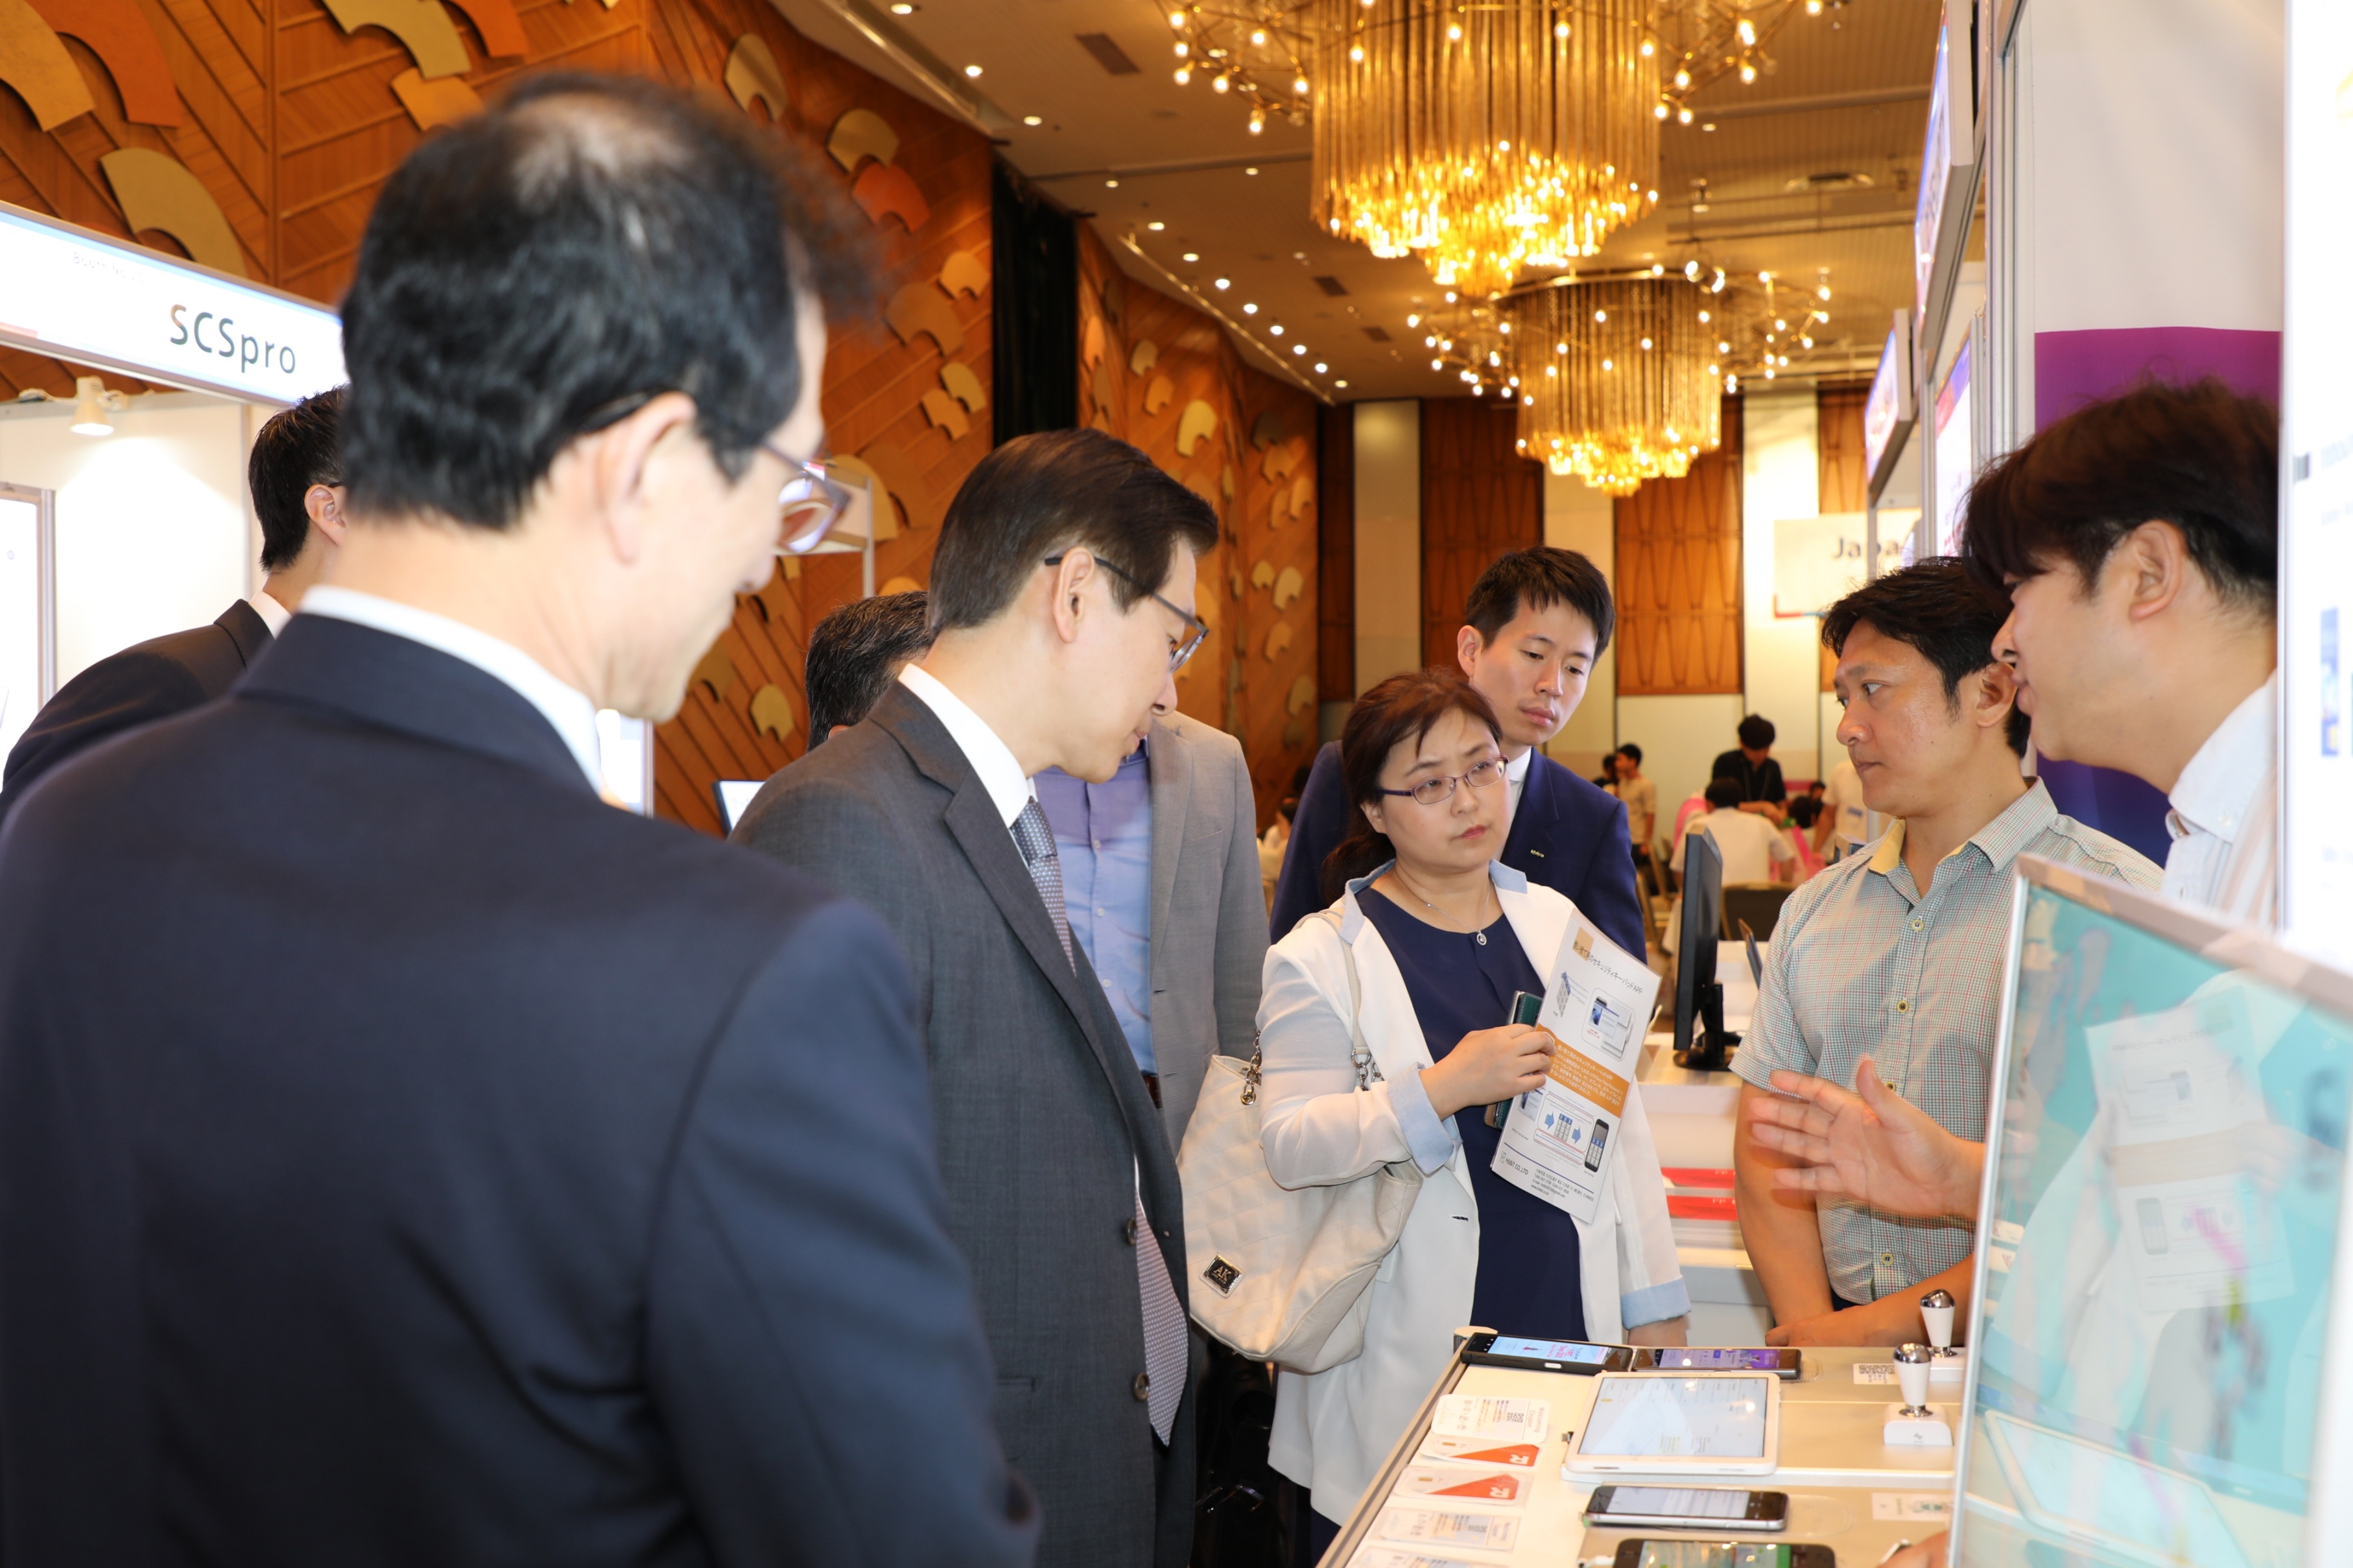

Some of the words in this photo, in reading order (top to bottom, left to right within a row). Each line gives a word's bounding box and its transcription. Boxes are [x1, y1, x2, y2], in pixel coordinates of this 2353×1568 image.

[73, 252, 107, 270] Booth
[169, 303, 296, 373] SCSpro
[1834, 537, 1899, 559] Jaa
[1213, 1266, 1232, 1282] AK
[1527, 1410, 1536, 1428] Coupon
[1533, 1407, 1546, 1433] Welcoming
